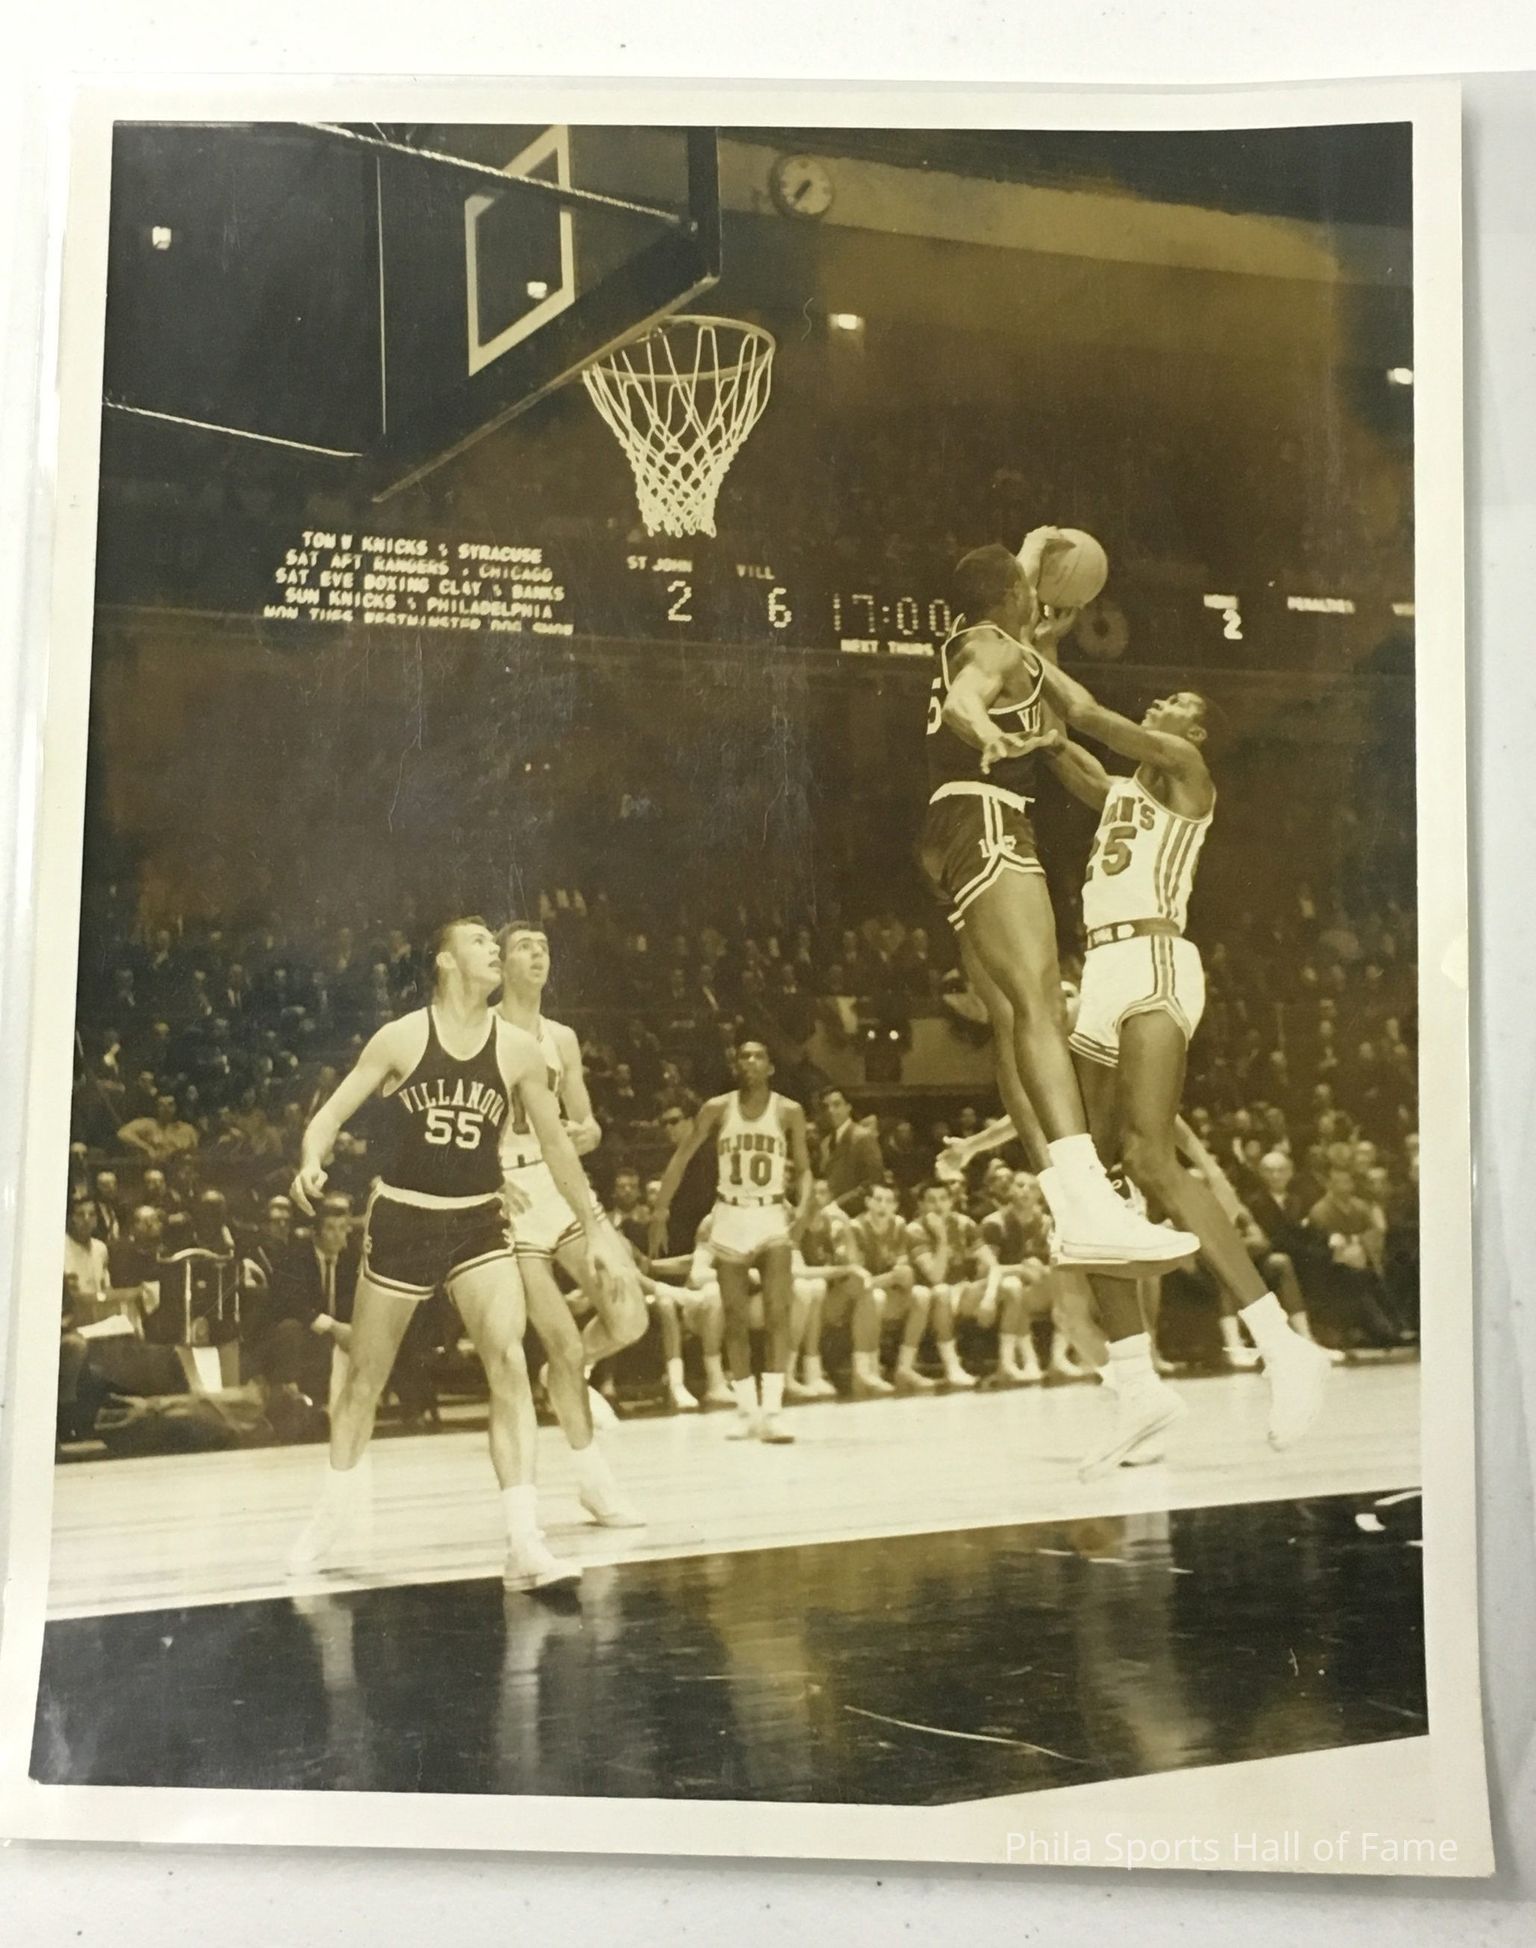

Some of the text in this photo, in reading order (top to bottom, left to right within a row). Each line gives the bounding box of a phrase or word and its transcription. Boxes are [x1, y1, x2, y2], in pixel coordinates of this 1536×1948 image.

[285, 549, 319, 567] SAT
[479, 563, 553, 583] CHICAGO
[361, 536, 428, 556] KNICKS
[458, 543, 543, 564] SYRACUSE
[626, 555, 648, 570] ST
[275, 567, 310, 585] SAT
[319, 570, 354, 588] EVE
[363, 573, 430, 593] BOXING
[439, 578, 482, 597] CLAY
[511, 583, 565, 602] BANKS
[736, 564, 776, 580] VILL
[285, 586, 320, 605] SUN
[329, 590, 397, 610] KNICKS
[427, 596, 553, 619] PHILADELPHIA
[667, 580, 692, 622] 2
[768, 587, 792, 628] 6
[1222, 609, 1243, 640] 2
[399, 1078, 506, 1128] VILLANOVA
[424, 1108, 484, 1149] 55
[730, 1153, 772, 1187] 10
